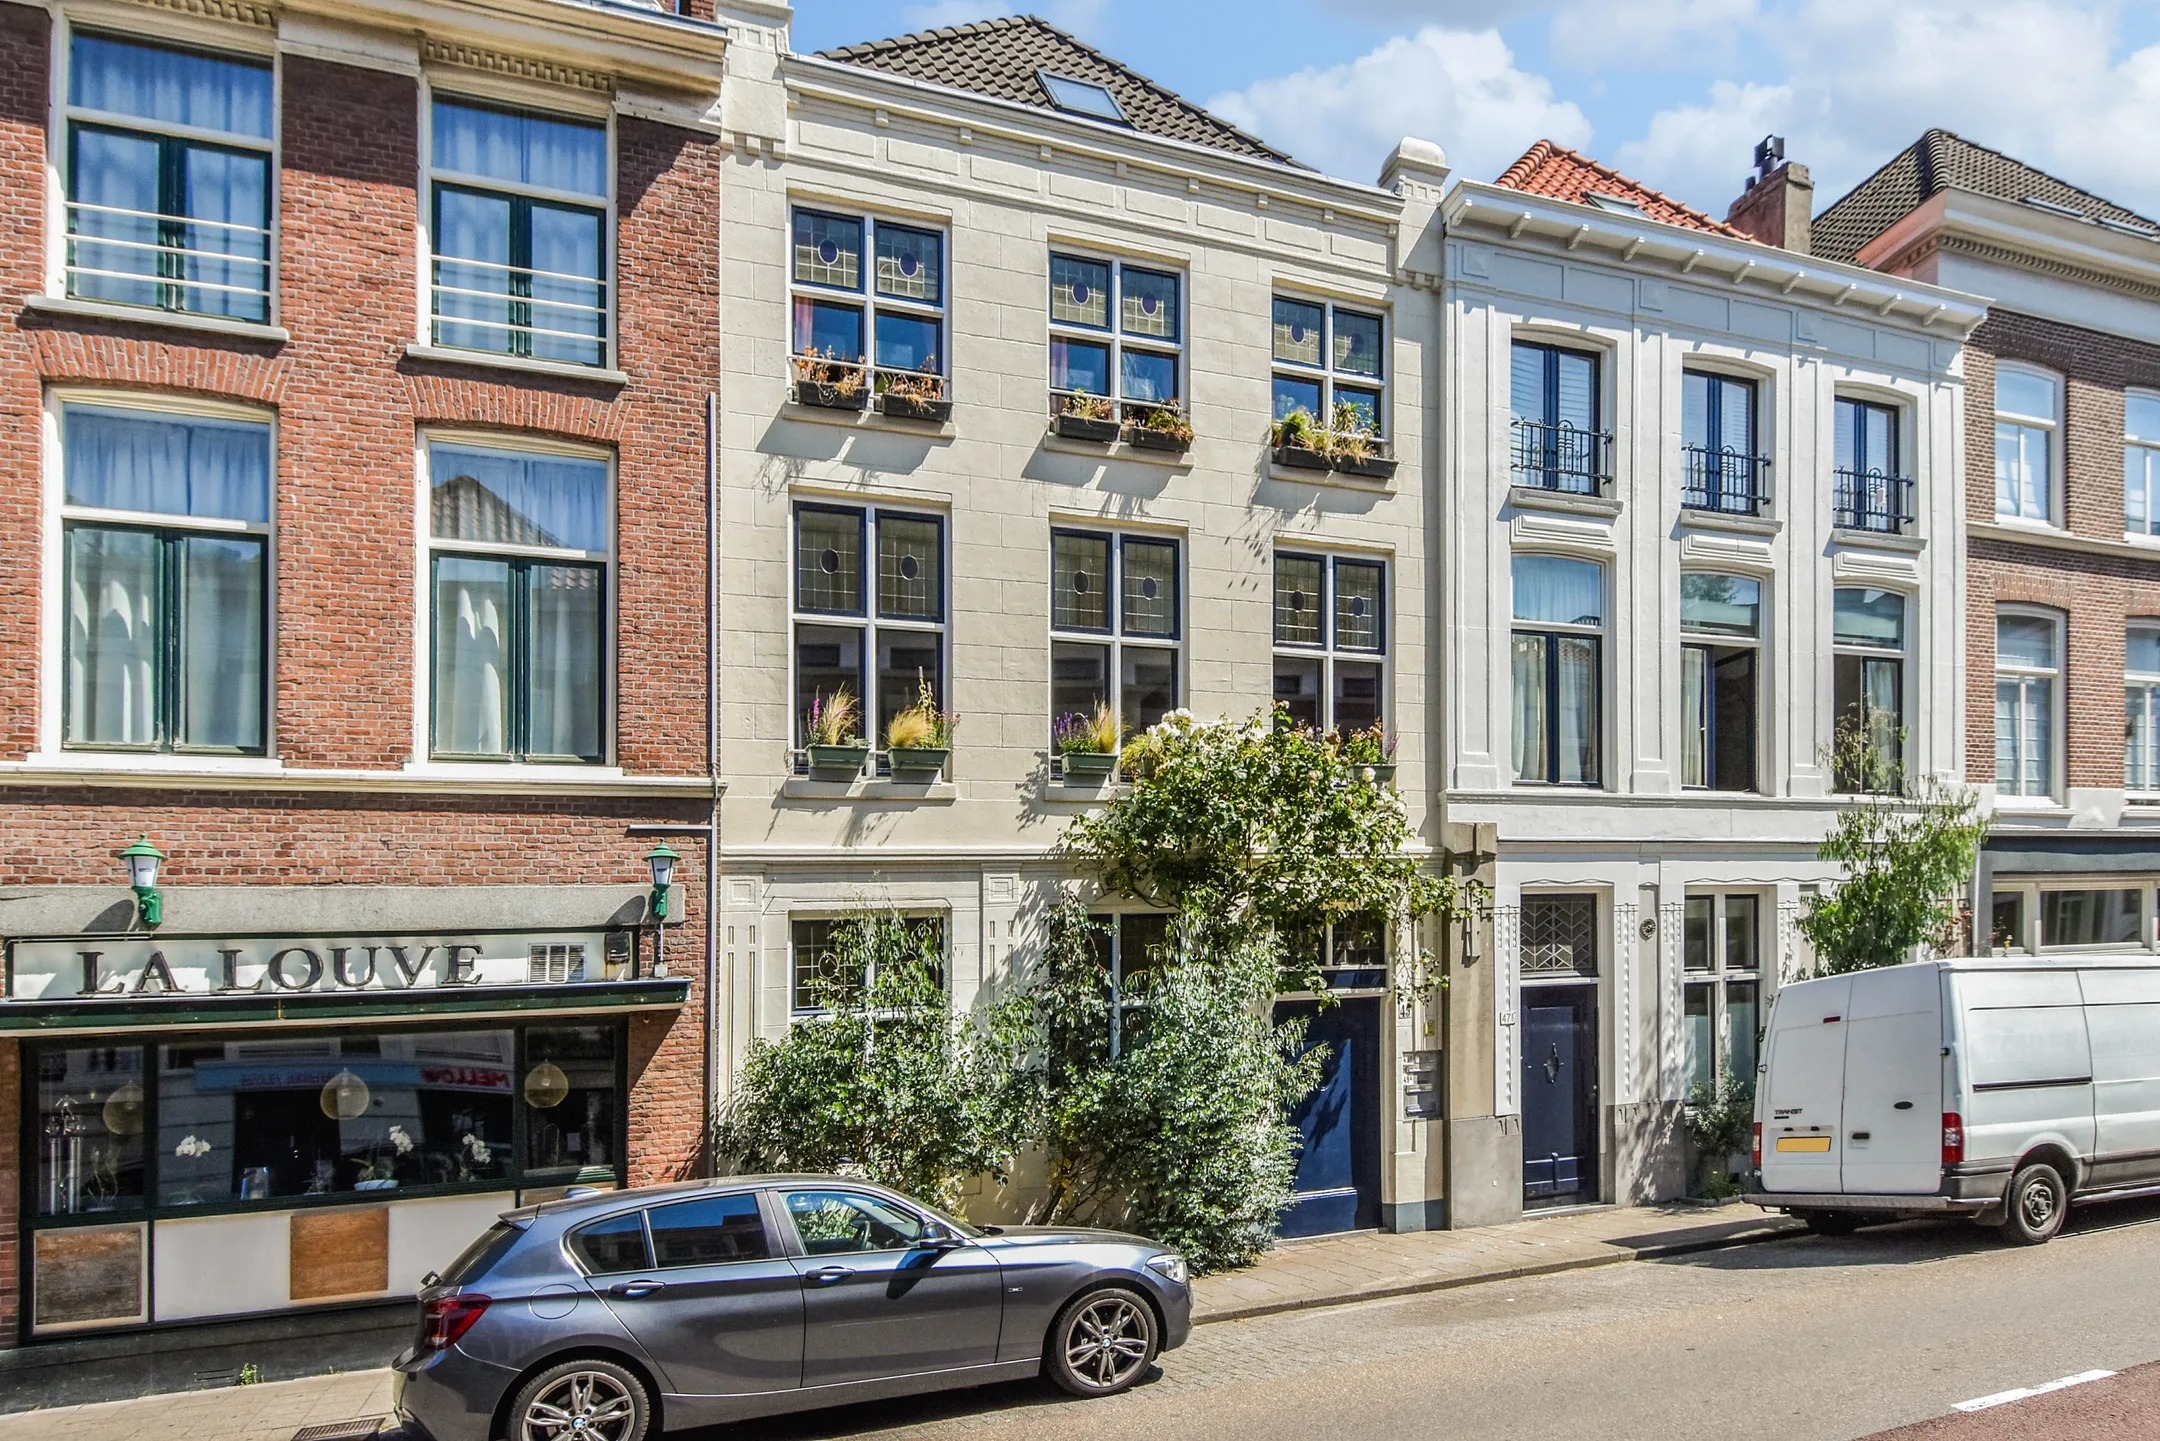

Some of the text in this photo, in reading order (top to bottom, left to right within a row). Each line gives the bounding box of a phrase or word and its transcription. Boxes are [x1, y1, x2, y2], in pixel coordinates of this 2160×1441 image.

[76, 943, 483, 995] LA LOUVE
[1774, 1108, 1804, 1116] TRANSIT
